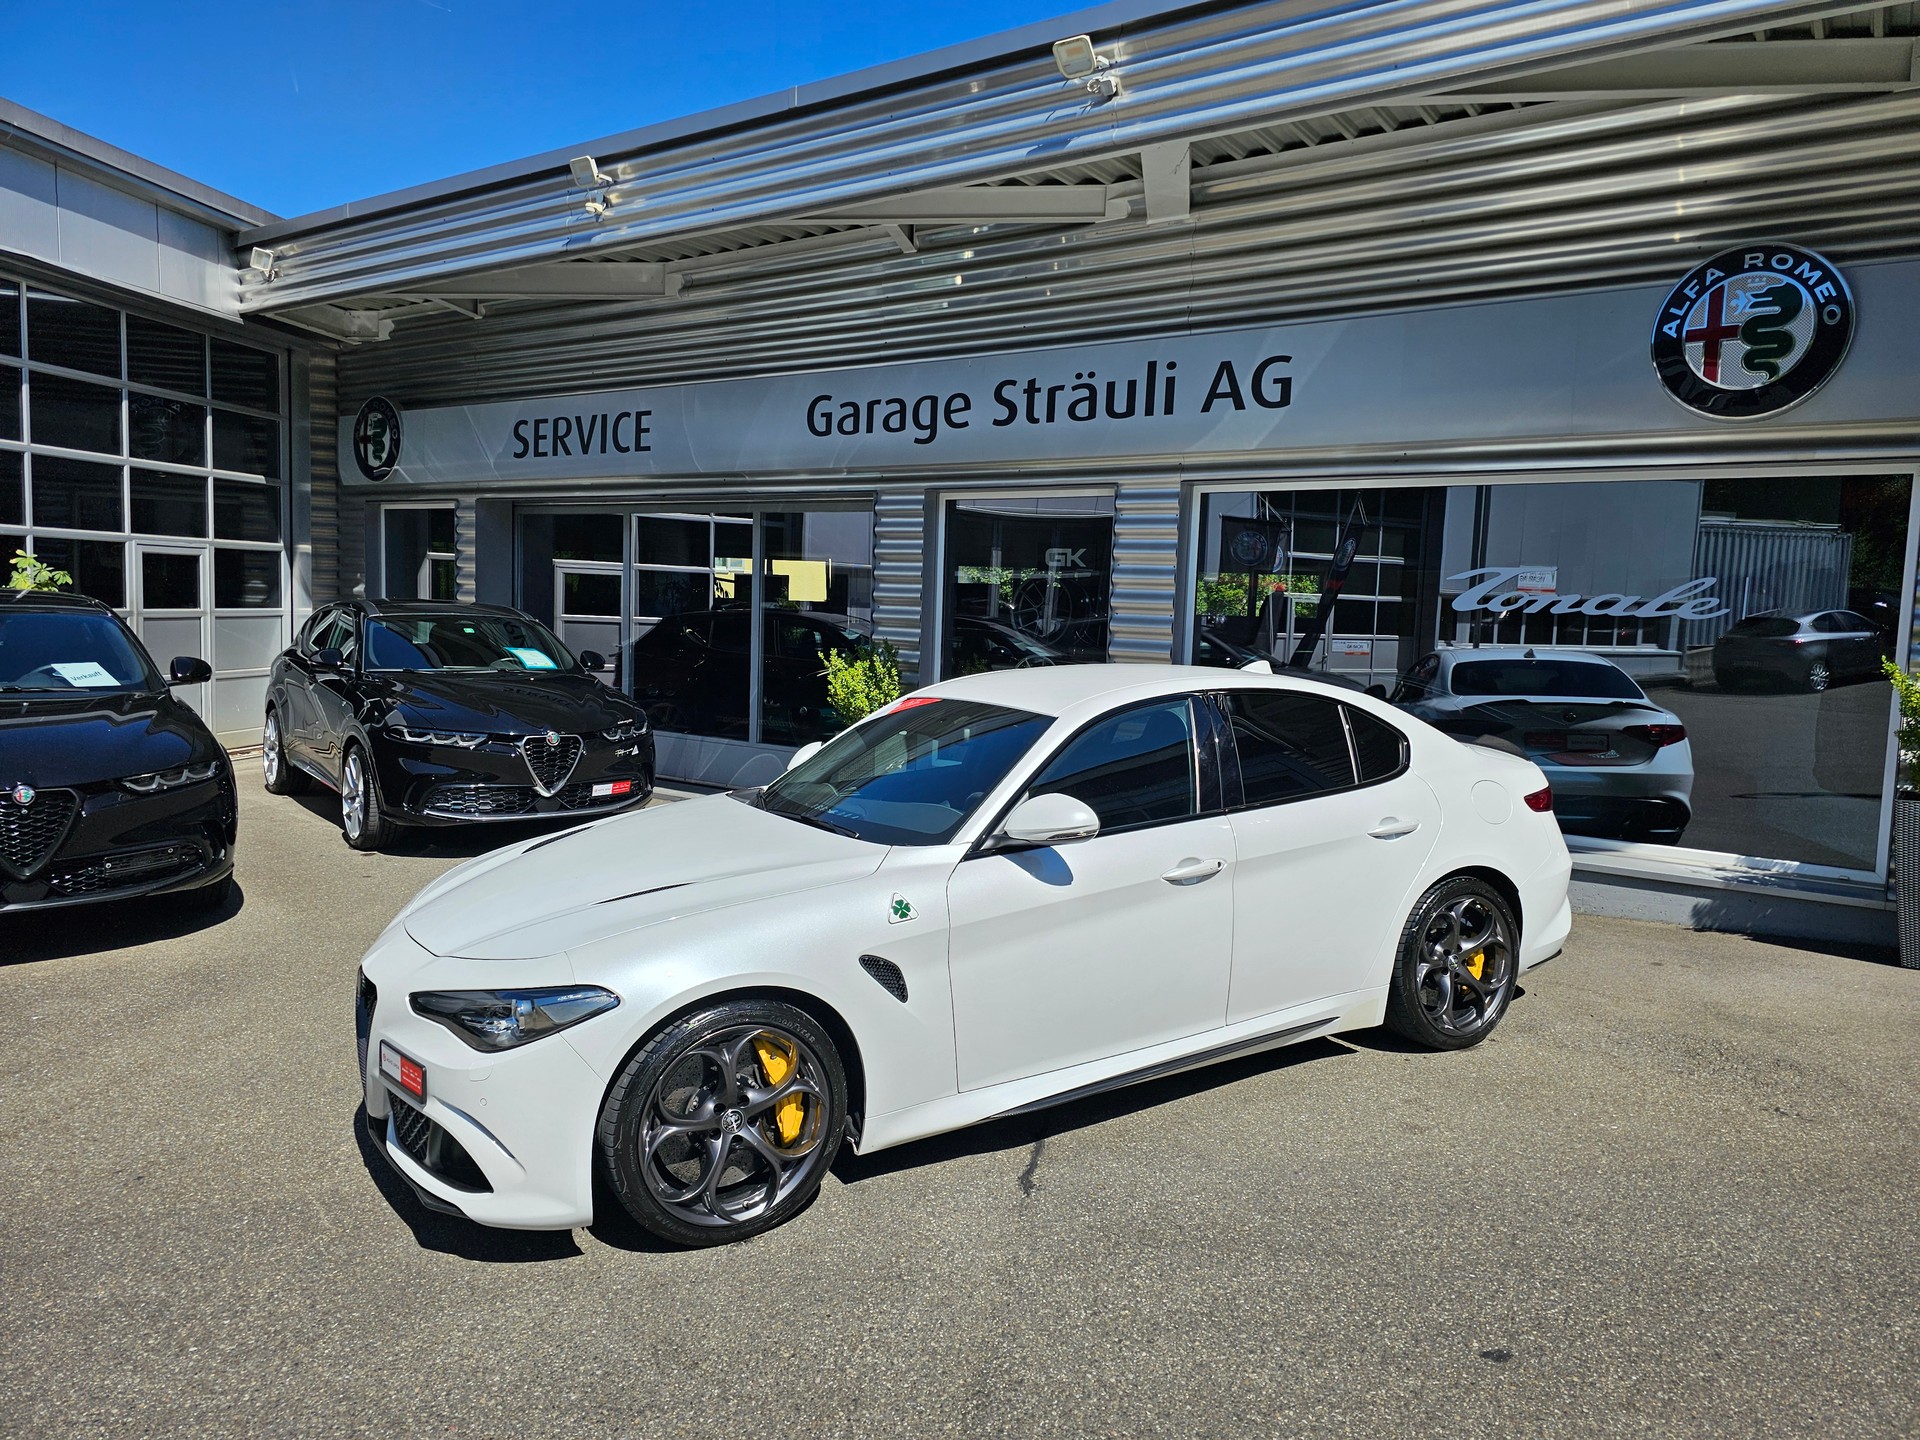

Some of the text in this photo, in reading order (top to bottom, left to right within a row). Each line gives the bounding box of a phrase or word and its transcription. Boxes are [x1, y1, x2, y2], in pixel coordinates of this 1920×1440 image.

[1662, 252, 1842, 338] ALFA ROMEO
[805, 354, 1294, 445] Garage Sträuli AG
[512, 409, 653, 460] SERVICE
[1446, 565, 1731, 620] Tonale
[69, 670, 103, 682] Verkauft
